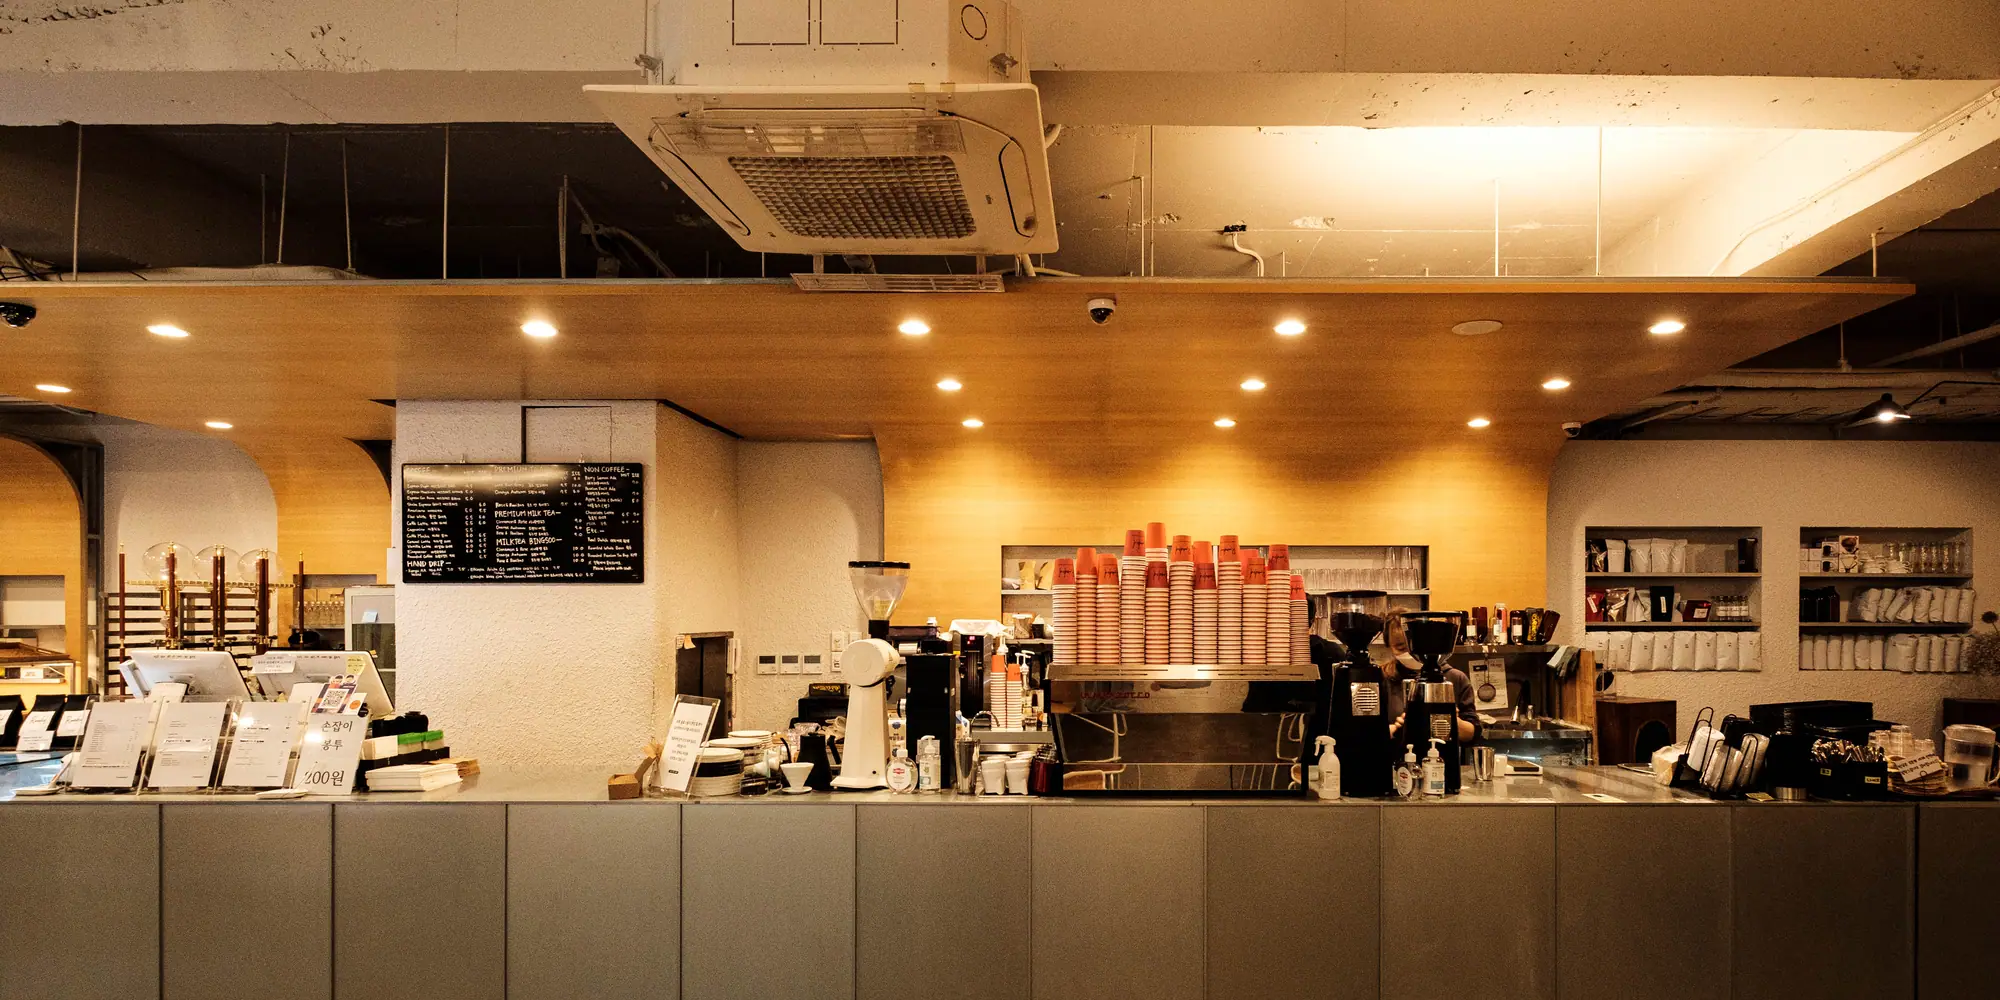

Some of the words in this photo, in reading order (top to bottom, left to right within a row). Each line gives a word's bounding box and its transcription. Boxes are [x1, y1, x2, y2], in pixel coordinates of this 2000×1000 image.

[601, 465, 625, 473] COFFEE
[494, 510, 526, 518] PREMIUM
[528, 536, 556, 546] BINGSOO
[406, 560, 427, 568] HAND
[428, 559, 445, 568] DRIP
[321, 720, 353, 733] 손잡이
[321, 739, 343, 751] 봉투
[304, 770, 344, 786] 200원
